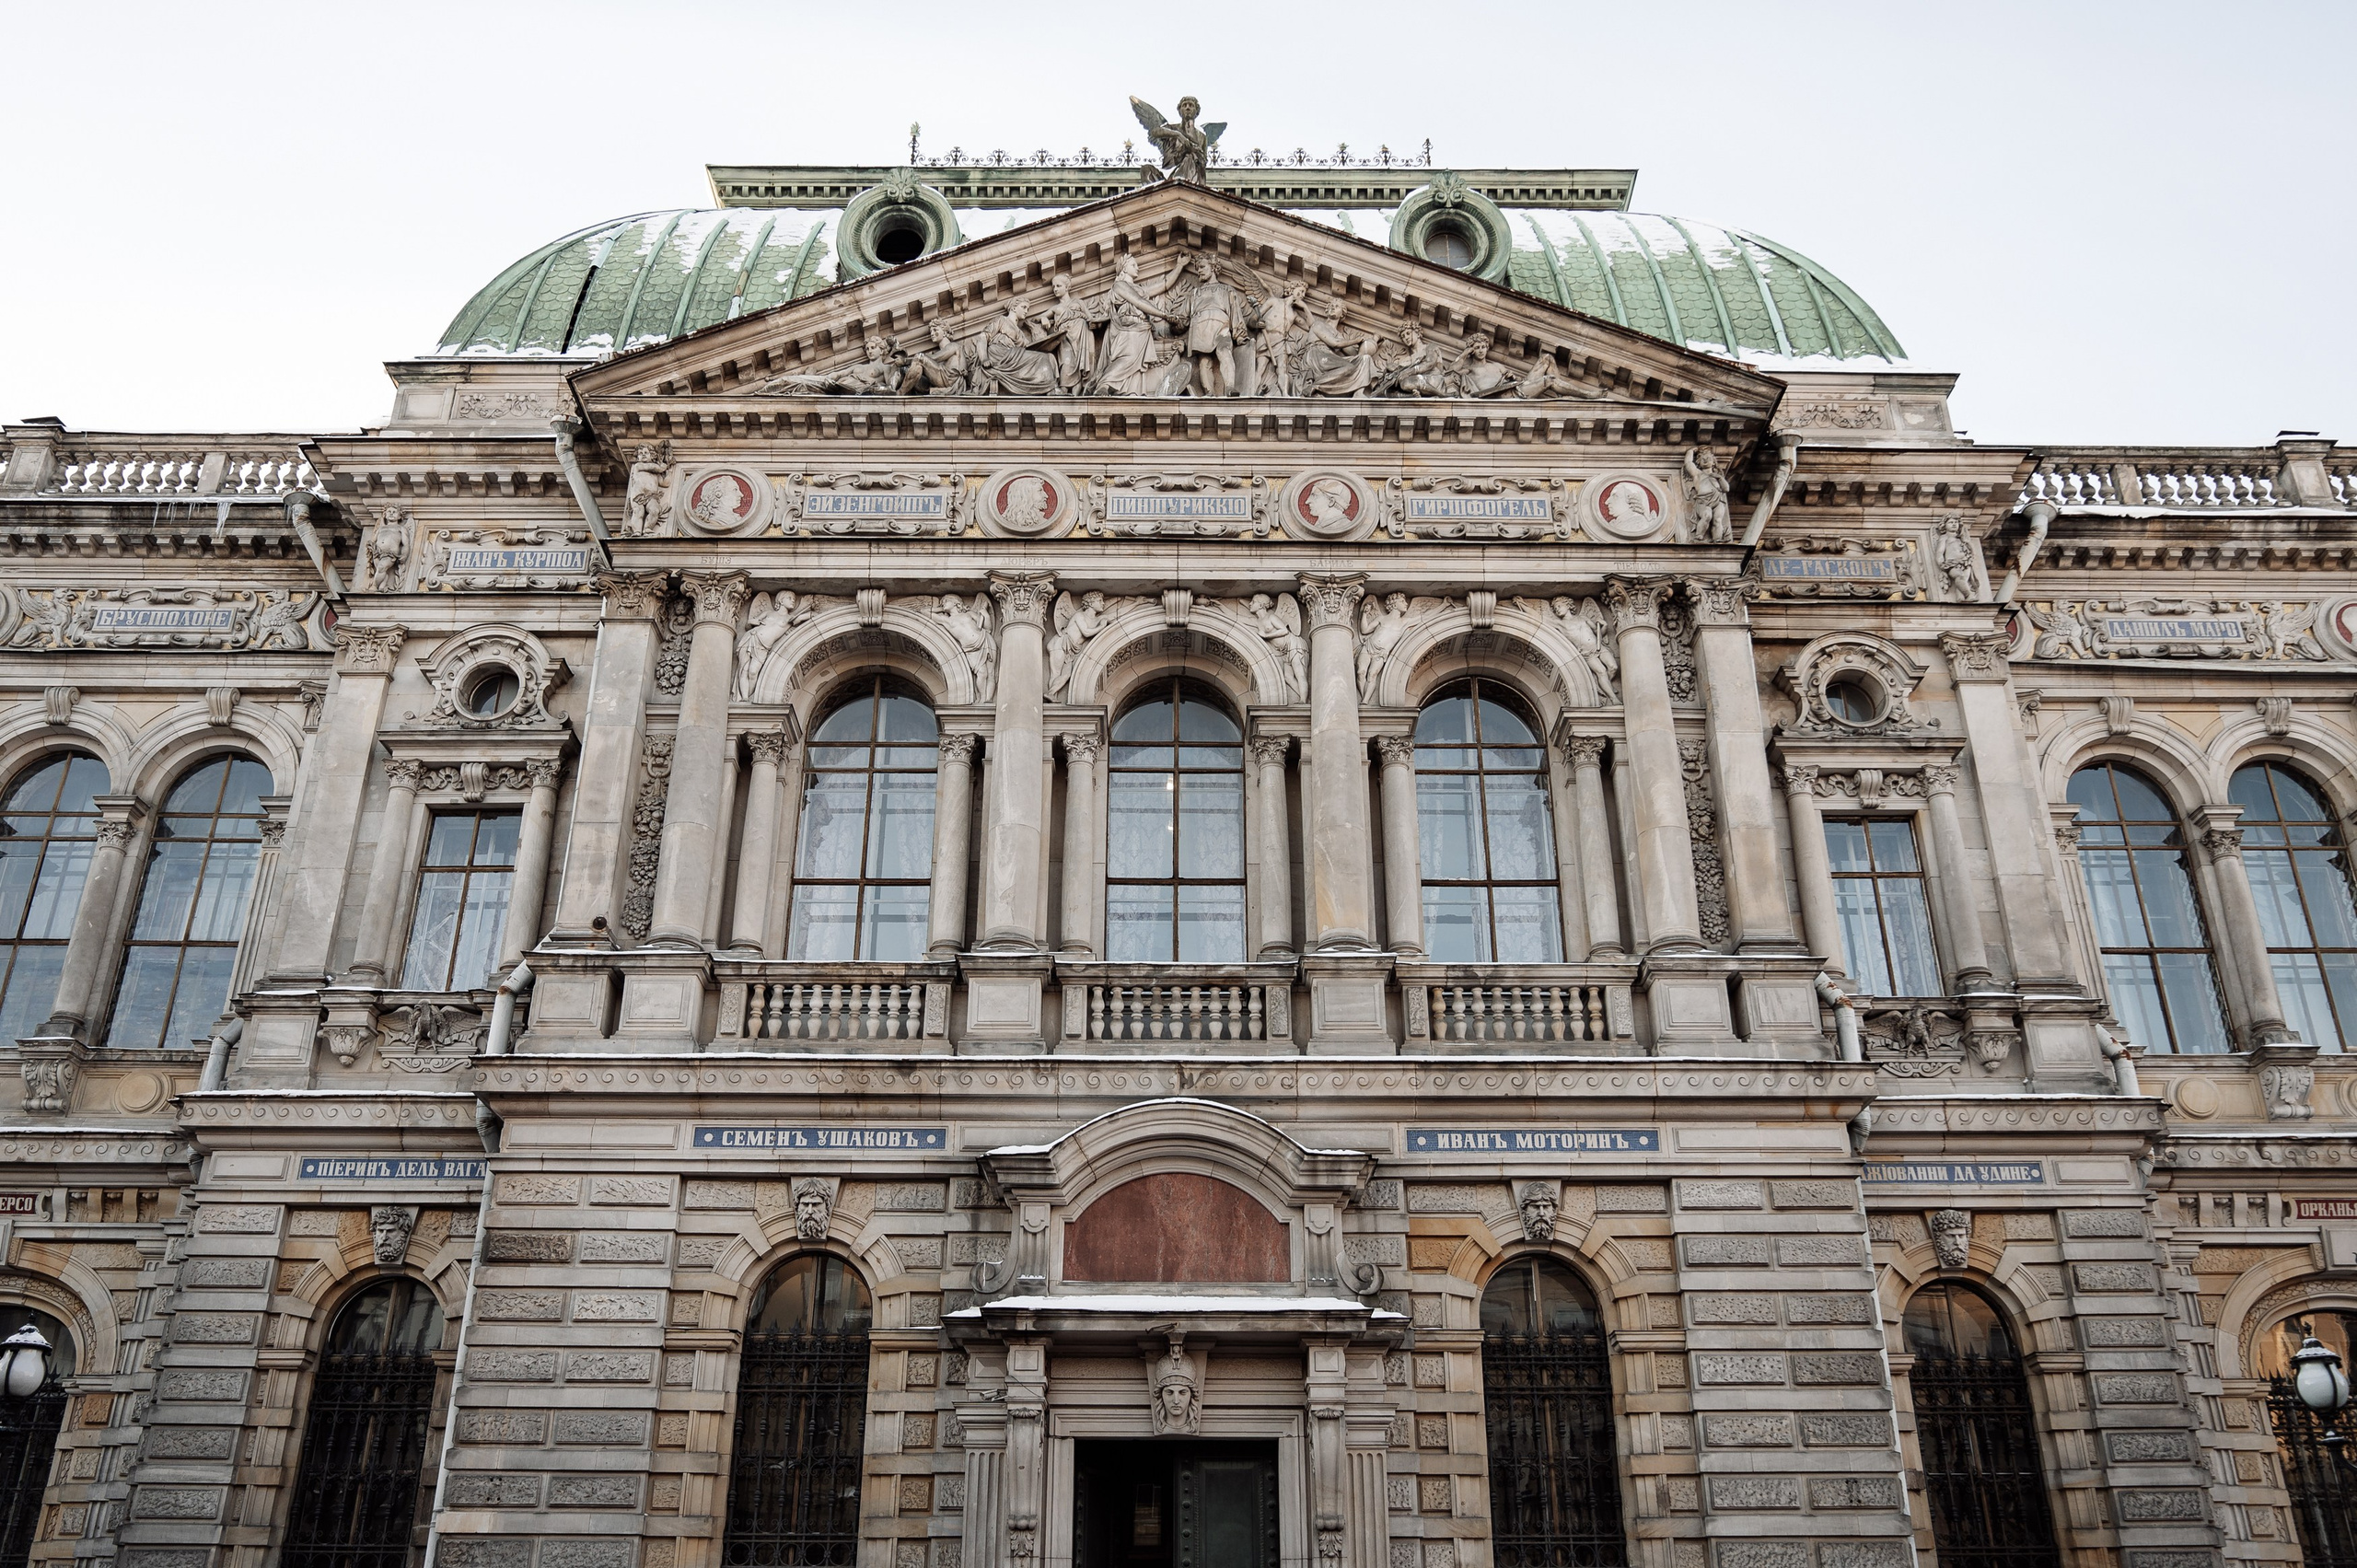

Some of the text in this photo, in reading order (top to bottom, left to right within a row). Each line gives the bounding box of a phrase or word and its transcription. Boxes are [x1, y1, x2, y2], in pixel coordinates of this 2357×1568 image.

[1411, 499, 1545, 517] ГИРШФОГЕЛЬ
[454, 552, 507, 568] ЖАНЪ
[2189, 621, 2237, 637] МАРО
[722, 1131, 919, 1147] СЕМЕНЪ УШАКОВЪ
[1436, 1132, 1630, 1149] ИВАНЪ МОТОРИНЪ
[395, 1162, 439, 1178] ДЕЛЬ
[442, 1162, 486, 1178] ВАГА
[1954, 1166, 1976, 1182] ДА
[1979, 1166, 2031, 1182] УДИНЕ
